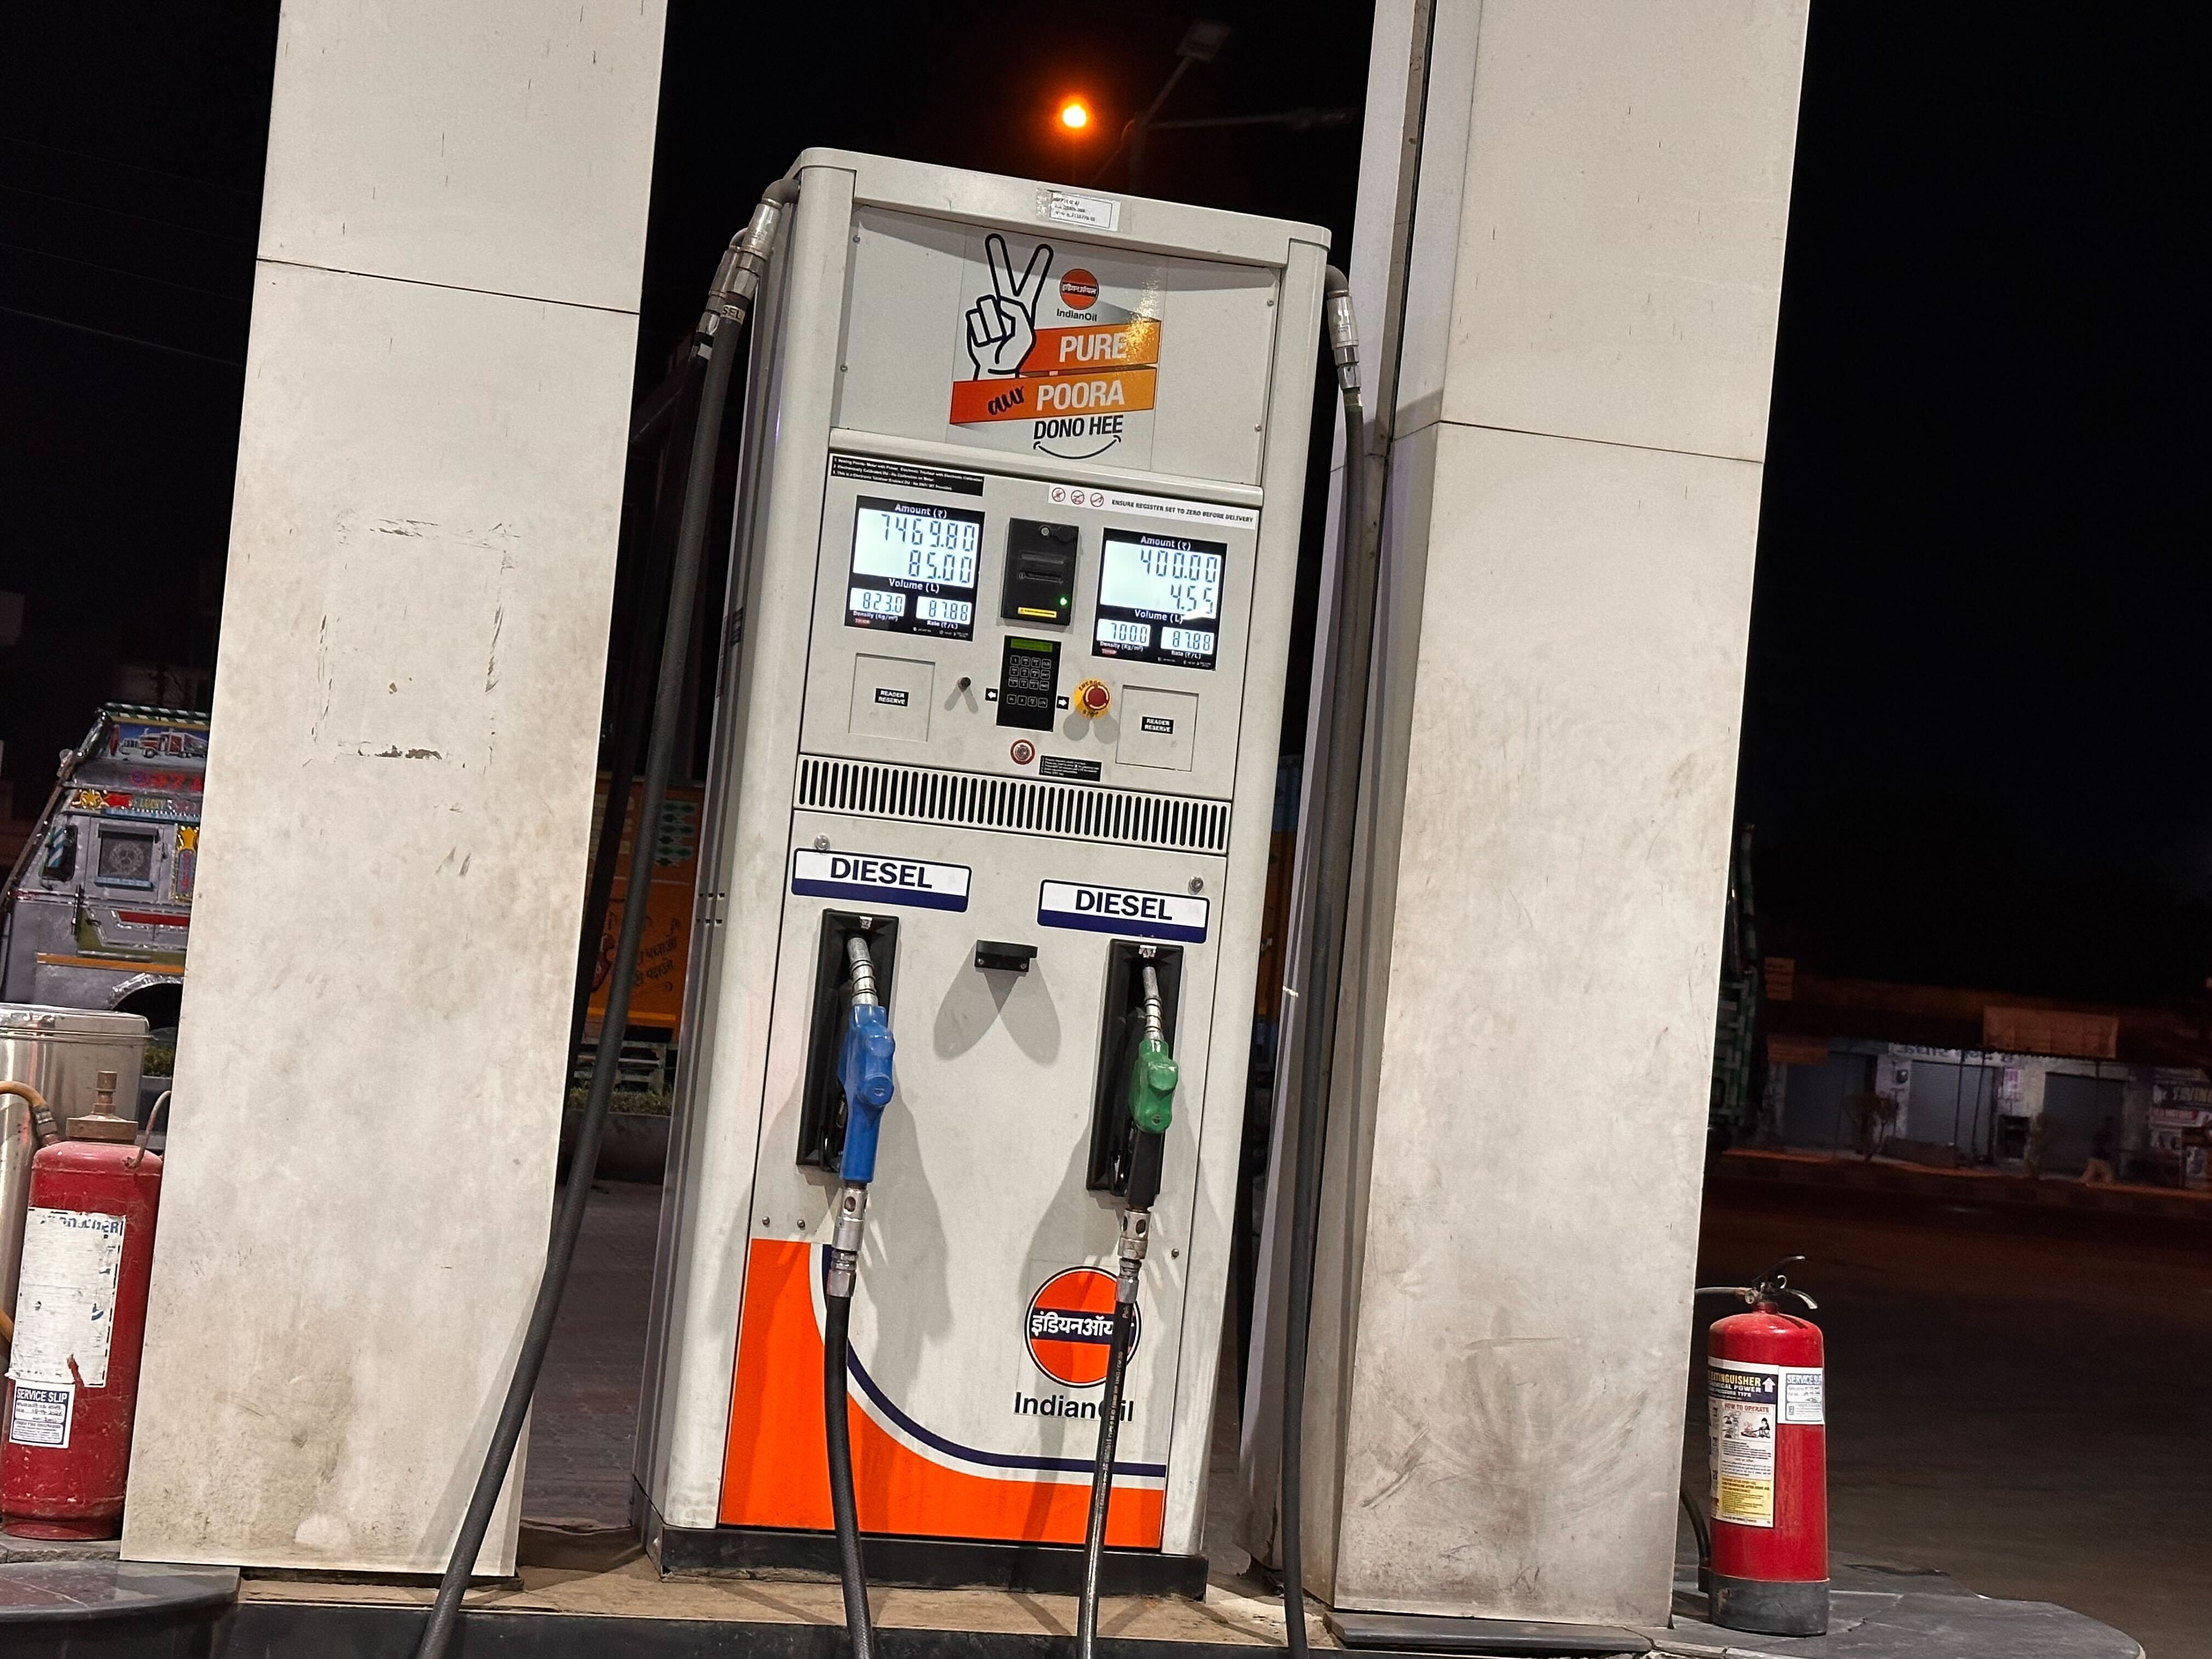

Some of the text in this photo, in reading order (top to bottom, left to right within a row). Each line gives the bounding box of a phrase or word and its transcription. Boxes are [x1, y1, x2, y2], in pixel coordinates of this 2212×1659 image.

[1057, 308, 1097, 321] IndianOil
[1059, 334, 1127, 362] PURE
[1036, 380, 1124, 410] POORA
[1034, 415, 1124, 439] DONO HEE
[895, 504, 931, 515] Amount
[1112, 499, 1134, 507] ENSURE
[1136, 502, 1164, 512] REGISTER
[1202, 511, 1224, 519] BEFORE
[1226, 514, 1253, 523] DELIVERY
[881, 514, 975, 552] 7469.80
[1141, 536, 1175, 547] Amount
[909, 550, 972, 583] 85.00
[1141, 549, 1217, 583] 400.00
[889, 578, 939, 594] Volume (L)
[863, 591, 902, 613] 823.0
[1171, 584, 1213, 614] 4.55
[853, 611, 874, 619] Density
[1135, 610, 1167, 621] Volume
[1111, 623, 1147, 643] 700.0
[878, 696, 905, 704] RESERVE
[830, 857, 933, 889] DIESEL
[1075, 889, 1172, 921] DIESEL
[1031, 1311, 1115, 1336] इंडियनऑय
[1734, 1385, 1761, 1393] POWER
[1787, 1374, 1814, 1384] SERVICE
[16, 1387, 67, 1403] SERVICE SLIP
[1015, 1392, 1134, 1422] Indianil
